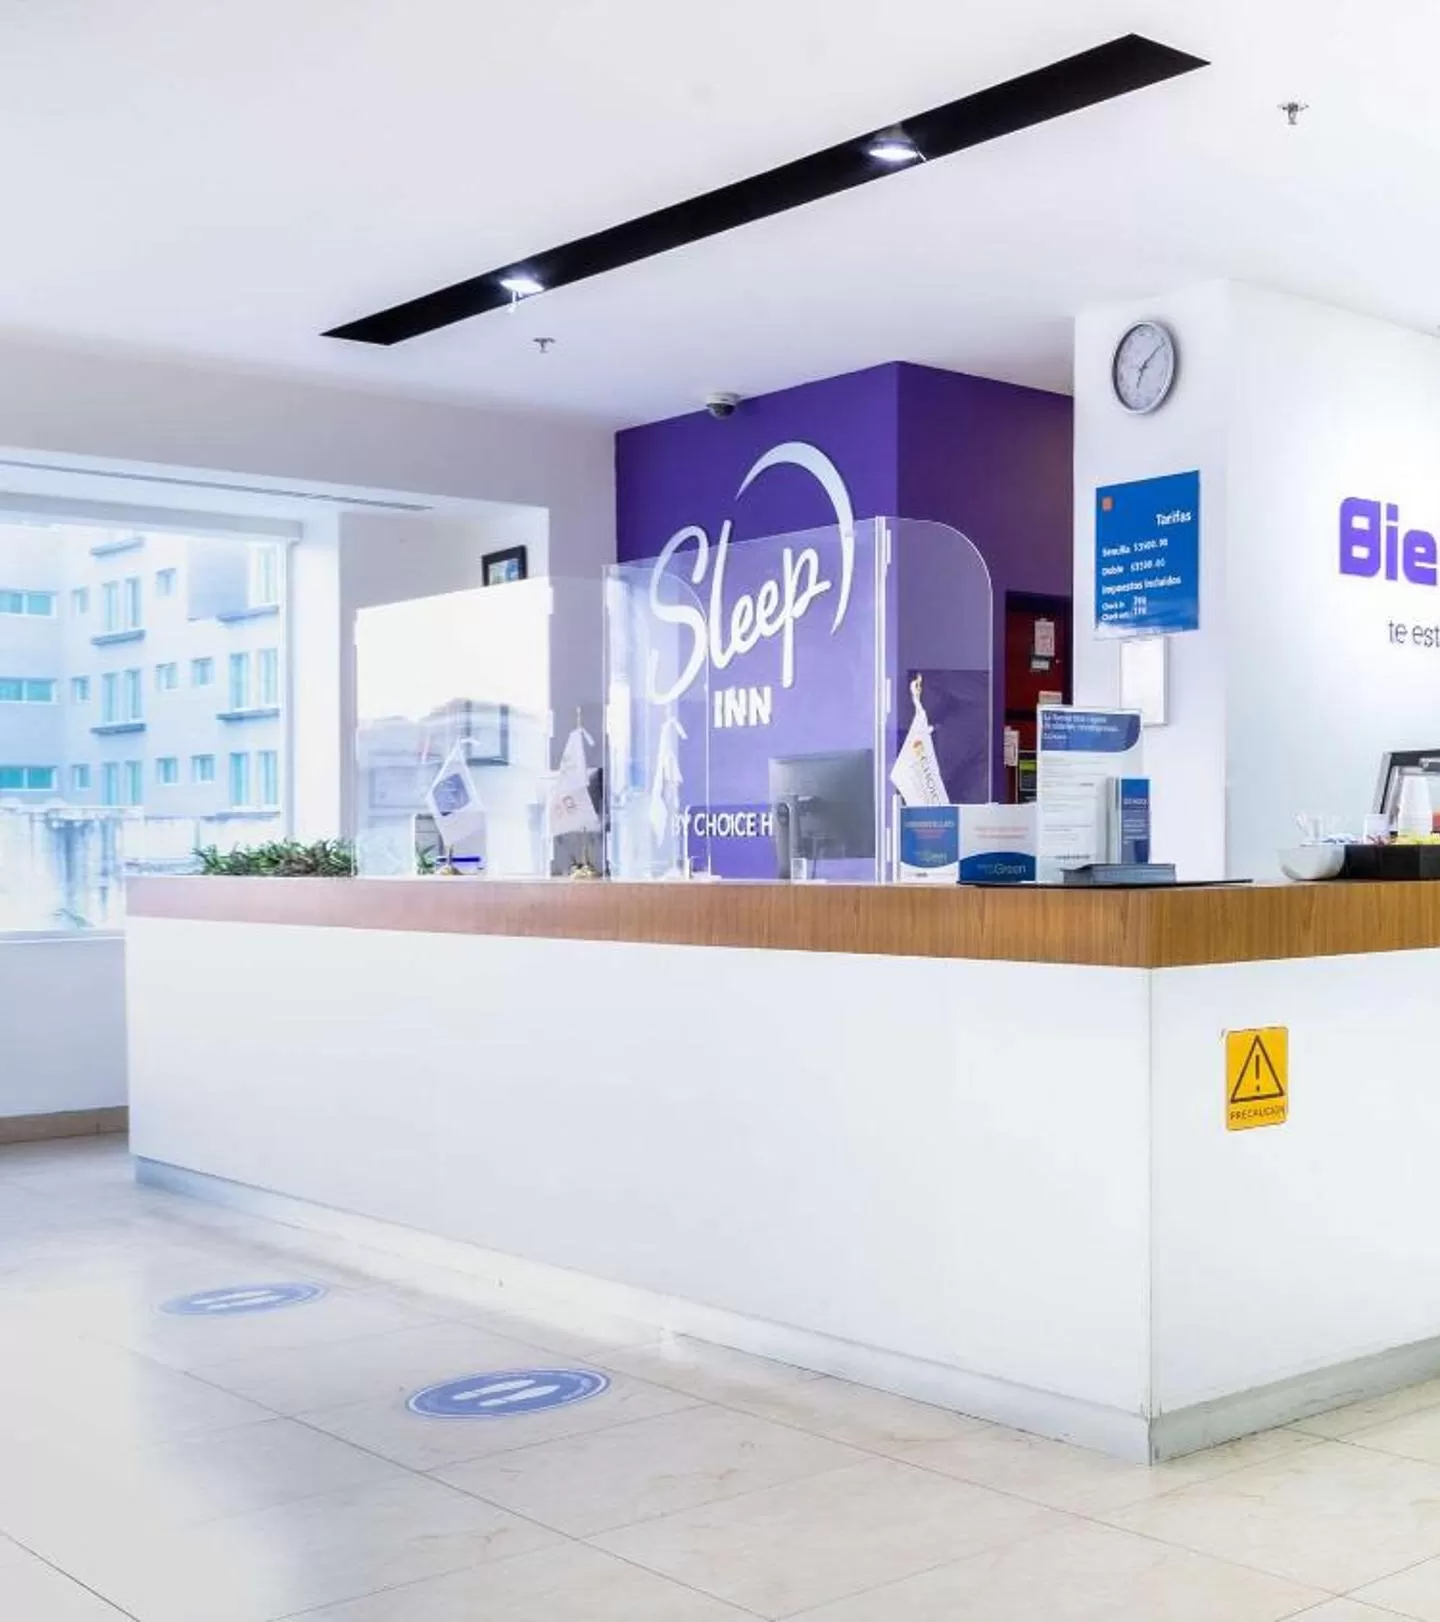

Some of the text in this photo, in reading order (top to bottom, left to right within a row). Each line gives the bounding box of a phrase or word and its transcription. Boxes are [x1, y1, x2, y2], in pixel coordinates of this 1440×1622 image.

[1155, 509, 1192, 526] Tarifas
[648, 519, 832, 705] Sleep
[1387, 618, 1409, 645] te
[713, 686, 772, 729] INN
[671, 813, 691, 836] BY
[694, 812, 757, 836] CHOICE
